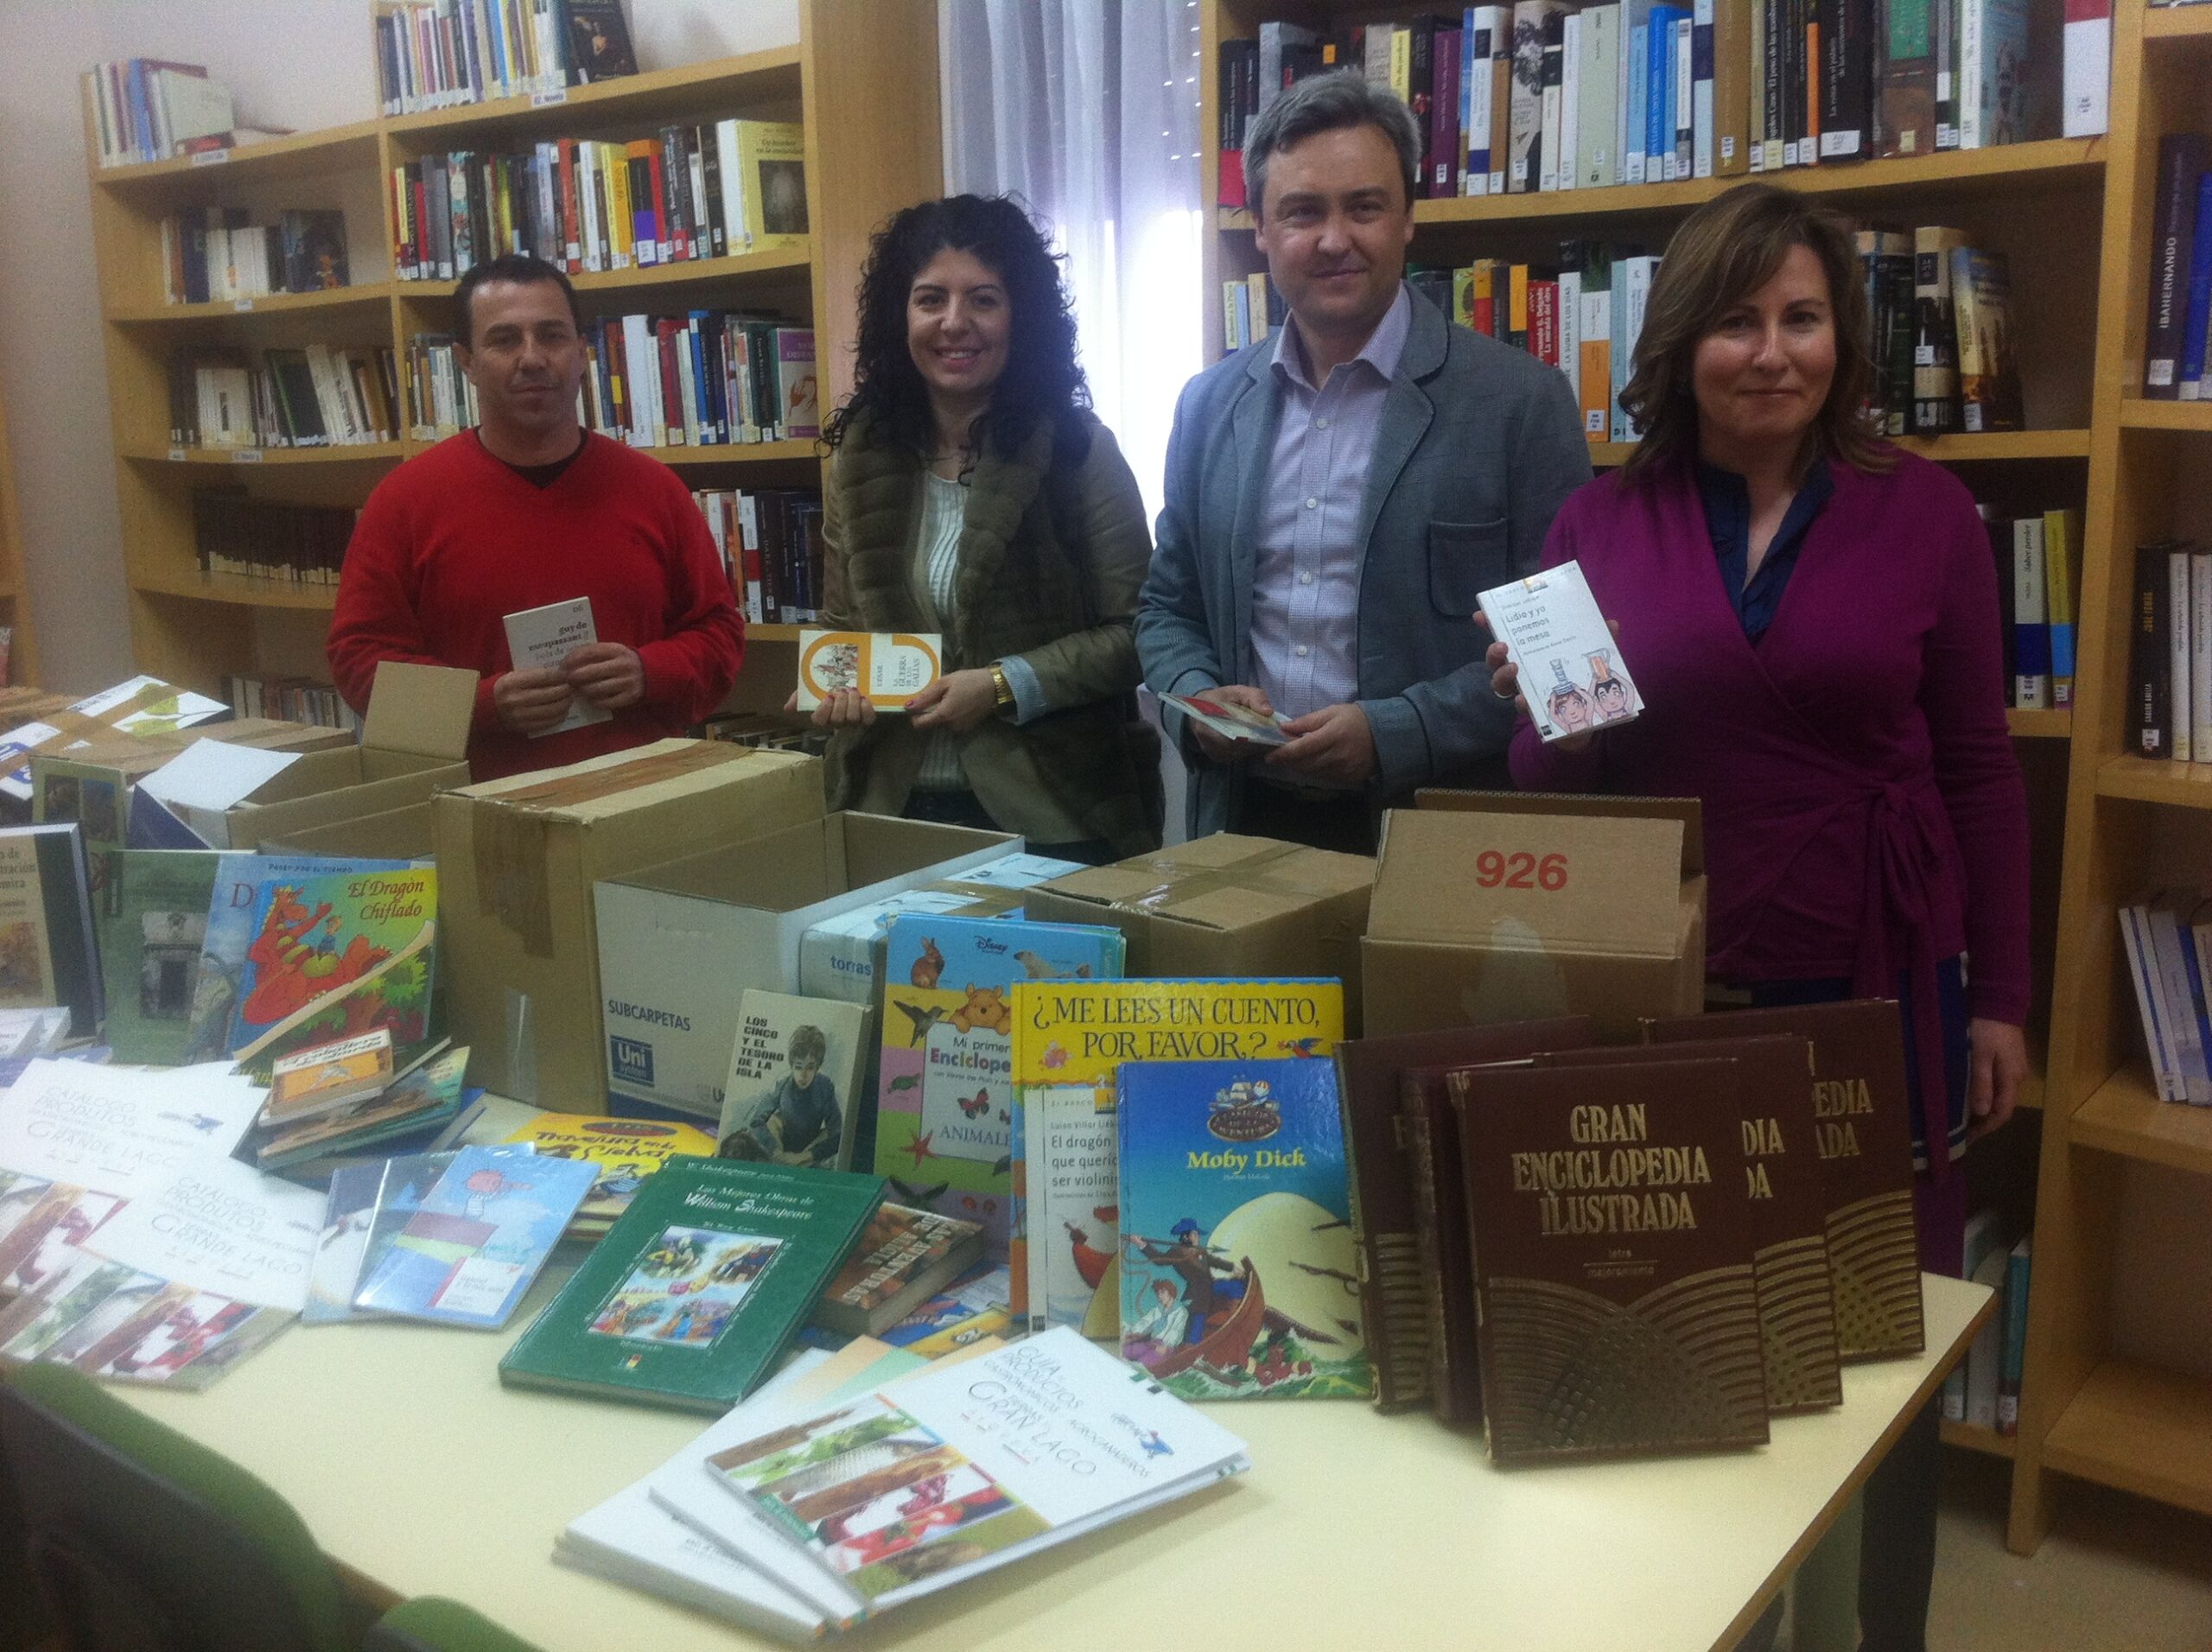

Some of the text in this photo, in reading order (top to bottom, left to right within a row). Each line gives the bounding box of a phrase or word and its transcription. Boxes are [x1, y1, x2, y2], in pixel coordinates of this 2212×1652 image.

[2159, 236, 2177, 329] IBAHERNANDO
[1535, 606, 1547, 617] yo
[575, 621, 588, 630] de
[1511, 617, 1550, 636] ponemos
[1515, 637, 1527, 646] la
[1527, 631, 1551, 644] mesa
[1475, 849, 1569, 892] 926
[347, 877, 424, 900] El Dragón
[359, 899, 423, 924] Chiflado
[974, 935, 1008, 954] Disney
[830, 955, 873, 977] torras
[608, 999, 691, 1032] SUBCARPETAS
[745, 1014, 768, 1027] LOS
[1033, 994, 1320, 1029] ¿ME LEES UN CUENTO,
[741, 1037, 767, 1049] Y EL
[743, 1026, 779, 1039] CINCO
[740, 1046, 785, 1062] TESORO
[953, 1036, 1011, 1052] Mi primer
[1083, 1031, 1143, 1060] POR
[618, 1043, 646, 1068] Uni
[738, 1058, 772, 1071] DE LA
[930, 1046, 1011, 1074] Enciclope
[736, 1068, 763, 1080] ISLA
[1569, 1102, 1647, 1143] GRAN
[1051, 1134, 1111, 1150] El dragón
[1052, 1156, 1076, 1170] que
[1186, 1147, 1307, 1176] Moby Dick
[1511, 1145, 1712, 1191] ENCICLOPEDIA
[1052, 1176, 1071, 1188] ser
[683, 1191, 814, 1221] William Shakespeare
[719, 1186, 762, 1200] Mejores
[799, 1196, 815, 1206] de
[1540, 1191, 1697, 1236] ILUSTRADA
[1031, 1428, 1097, 1474] LAGO
